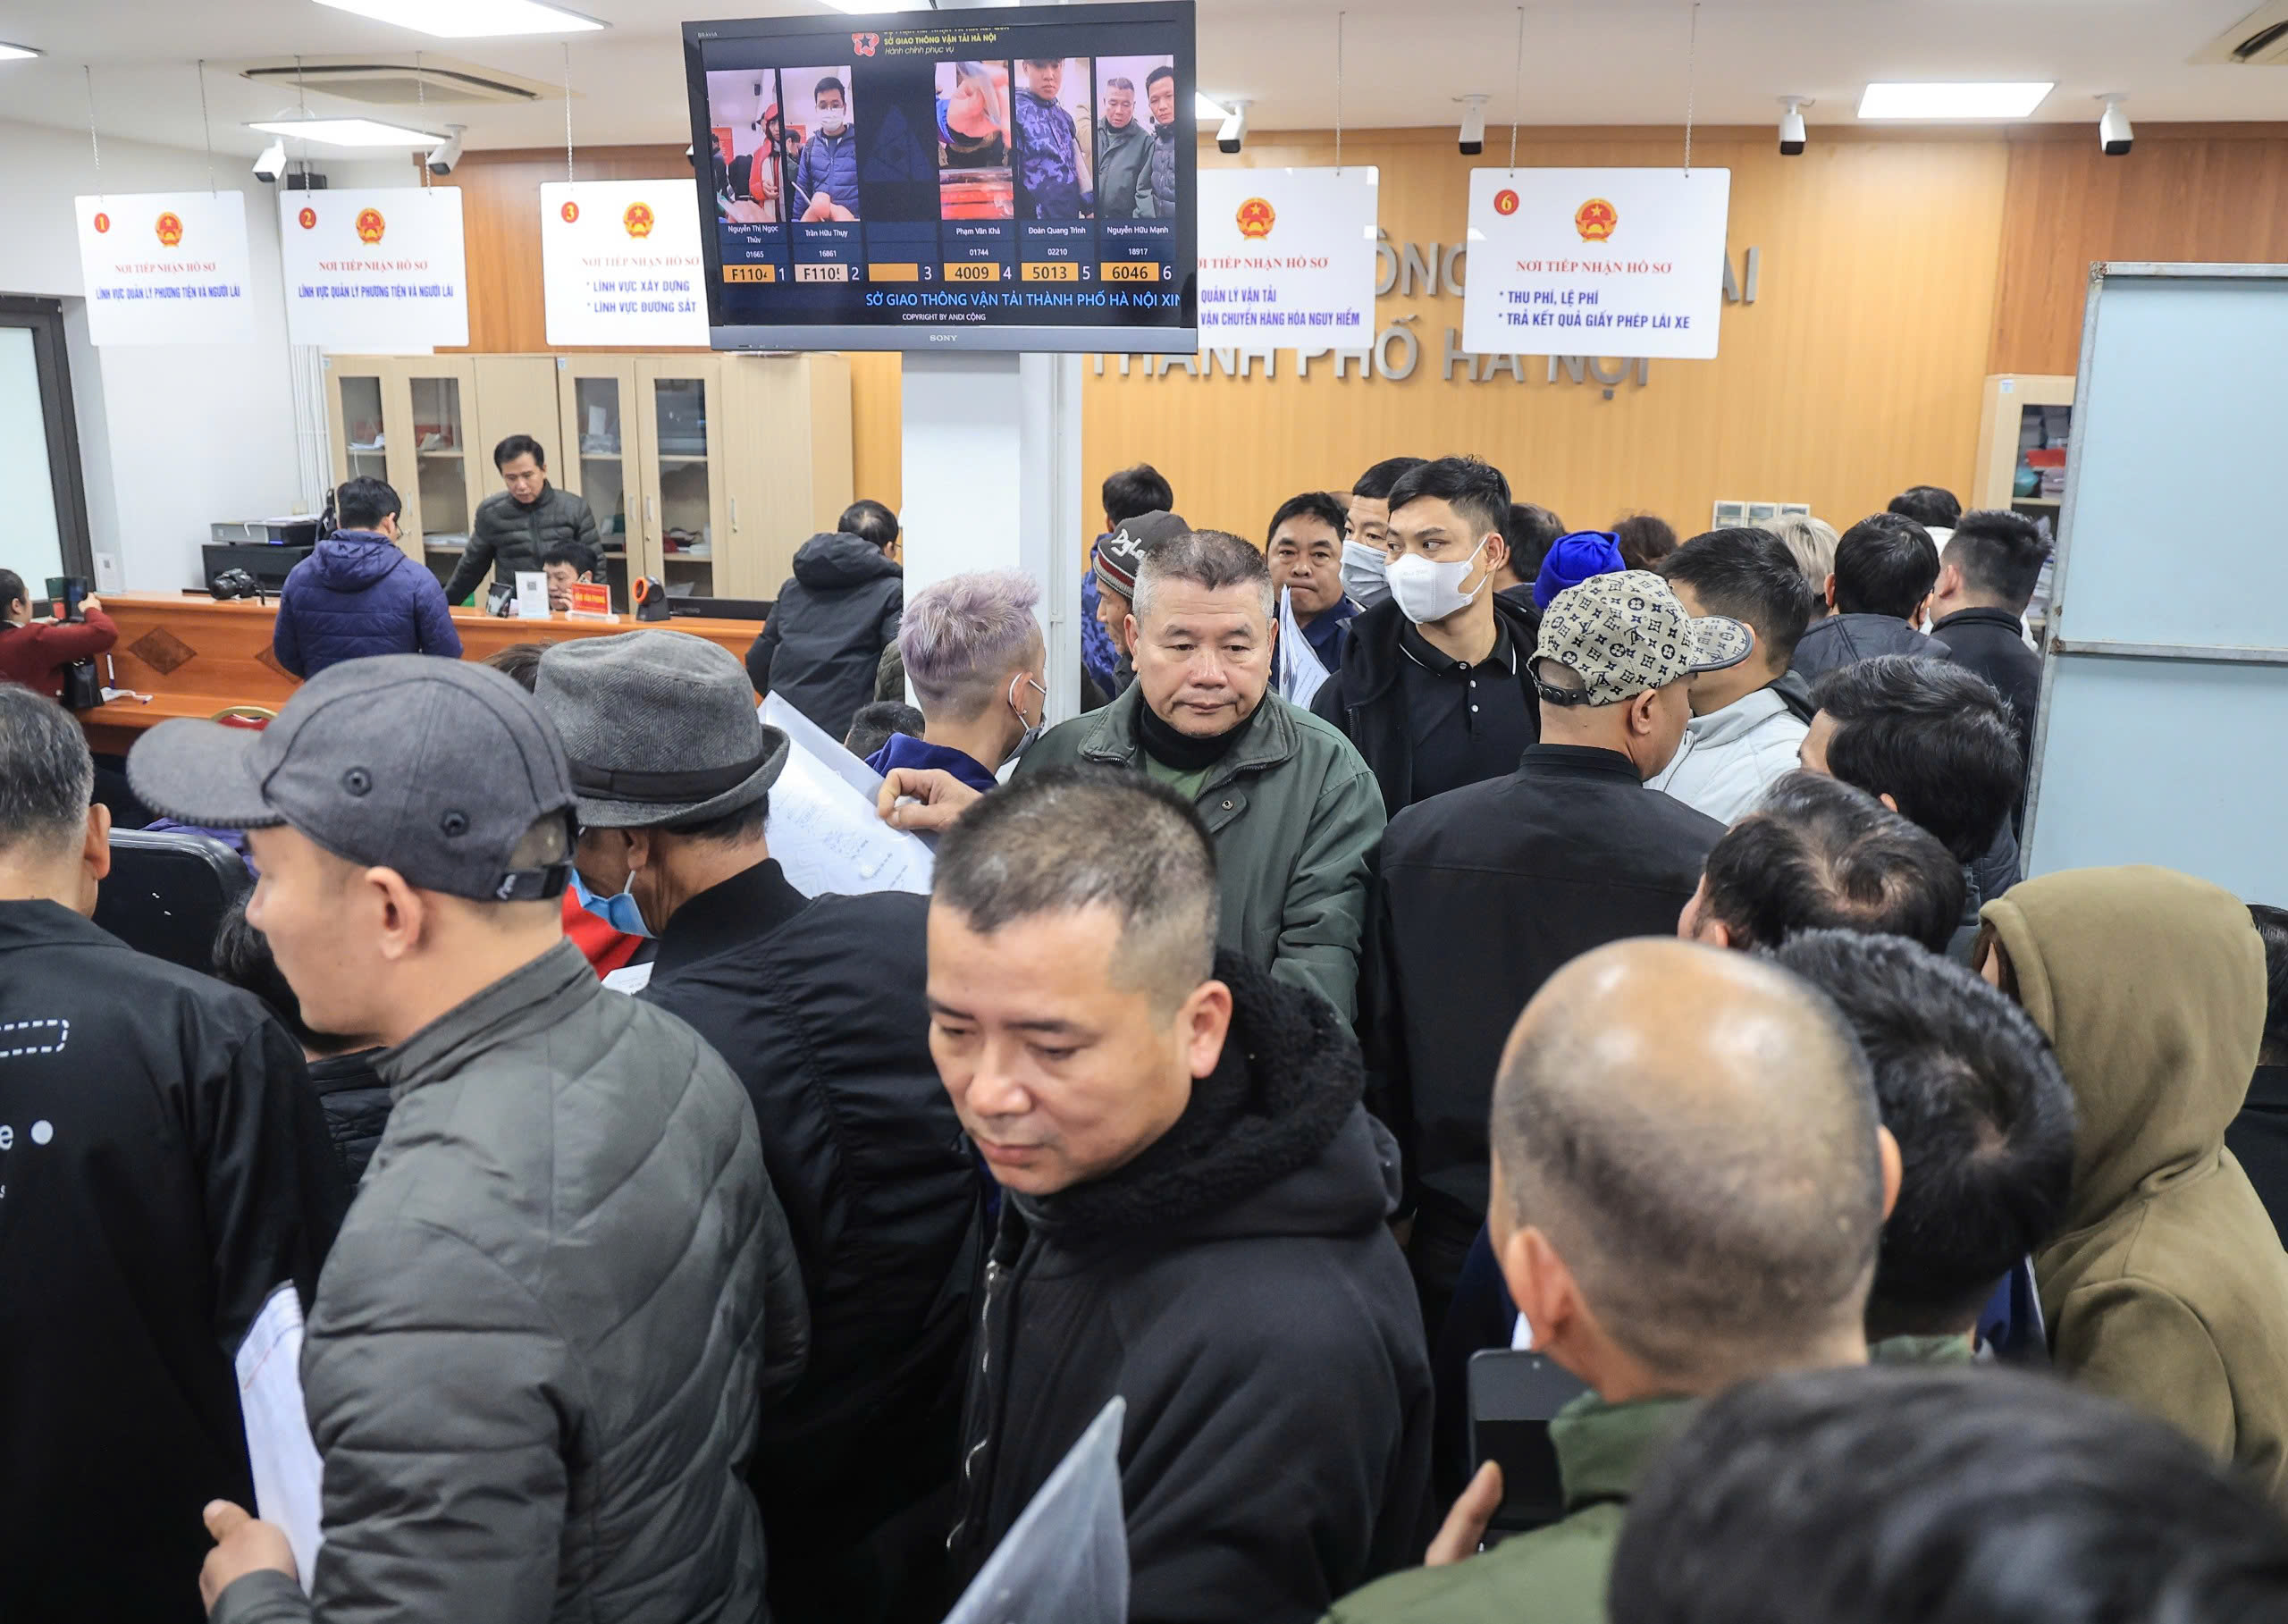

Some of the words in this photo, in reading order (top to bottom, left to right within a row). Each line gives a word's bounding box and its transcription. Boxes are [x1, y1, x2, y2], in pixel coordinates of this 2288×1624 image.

[896, 36, 913, 45] GIAO
[915, 34, 939, 45] THÔNG
[941, 34, 957, 45] VẬN
[971, 32, 981, 42] HÀ
[1502, 194, 1513, 211] 6
[302, 211, 313, 225] 2
[566, 204, 575, 221] 3
[99, 215, 105, 230] 1
[955, 227, 974, 236] Phạm
[1047, 227, 1068, 236] Quang
[1149, 226, 1169, 235] Mạnh
[745, 250, 764, 258] 01665
[969, 248, 989, 257] 01744
[1047, 248, 1068, 256] 02210
[1128, 248, 1148, 256] 18917
[1212, 256, 1241, 268] TIẾP
[1244, 257, 1283, 272] NHẬN
[1286, 255, 1307, 268] HỒ
[1309, 257, 1330, 268] SƠ
[1516, 260, 1543, 272] NƠI
[1545, 258, 1578, 273] TIẾP
[1581, 261, 1623, 275] NHẬN
[1627, 259, 1649, 273] HỒ
[1652, 261, 1673, 273] SƠ
[778, 268, 785, 281] 1
[851, 266, 860, 281] 2
[924, 265, 932, 280] 3
[955, 266, 989, 280] 4009
[1003, 266, 1013, 280] 4
[1032, 266, 1067, 280] 5013
[1082, 266, 1090, 280] 5
[1112, 266, 1148, 280] 6046
[1163, 265, 1172, 280] 6
[865, 290, 884, 307] SỞ
[886, 292, 918, 307] GIAO
[921, 290, 967, 307] THÔNG
[970, 290, 998, 310] VẬN
[1001, 290, 1022, 307] TẢI
[1026, 290, 1073, 307] THÀNH
[1077, 290, 1106, 307] PHỐ
[1109, 291, 1130, 307] HÀ
[1134, 290, 1157, 309] NỘI
[1200, 285, 1226, 303] QUẢN
[1228, 287, 1239, 302] LÝ
[1241, 286, 1259, 305] VẬN
[1262, 284, 1277, 302] TẢI
[1508, 290, 1530, 304] THU
[1534, 289, 1558, 306] PHÍ,
[1560, 289, 1574, 307] LỆ
[1578, 290, 1599, 305] PHÍ
[902, 313, 938, 321] COPYRIGHT
[939, 313, 947, 321] BY
[948, 313, 965, 321] ANDI
[1200, 309, 1219, 328] VẬN
[1221, 307, 1258, 325] CHUYỂN
[1259, 309, 1285, 325] HÀNG
[1308, 312, 1333, 325] NGUY
[1336, 307, 1360, 325] HIỂM
[1507, 308, 1529, 325] TRẢ
[1532, 309, 1555, 326] KẾT
[1557, 309, 1582, 327] QUẢ
[1585, 309, 1612, 327] GIẤY
[1616, 313, 1648, 328] PHÉP
[1652, 313, 1670, 328] LÁI
[1674, 316, 1690, 329] XE
[930, 334, 958, 342] SONY
